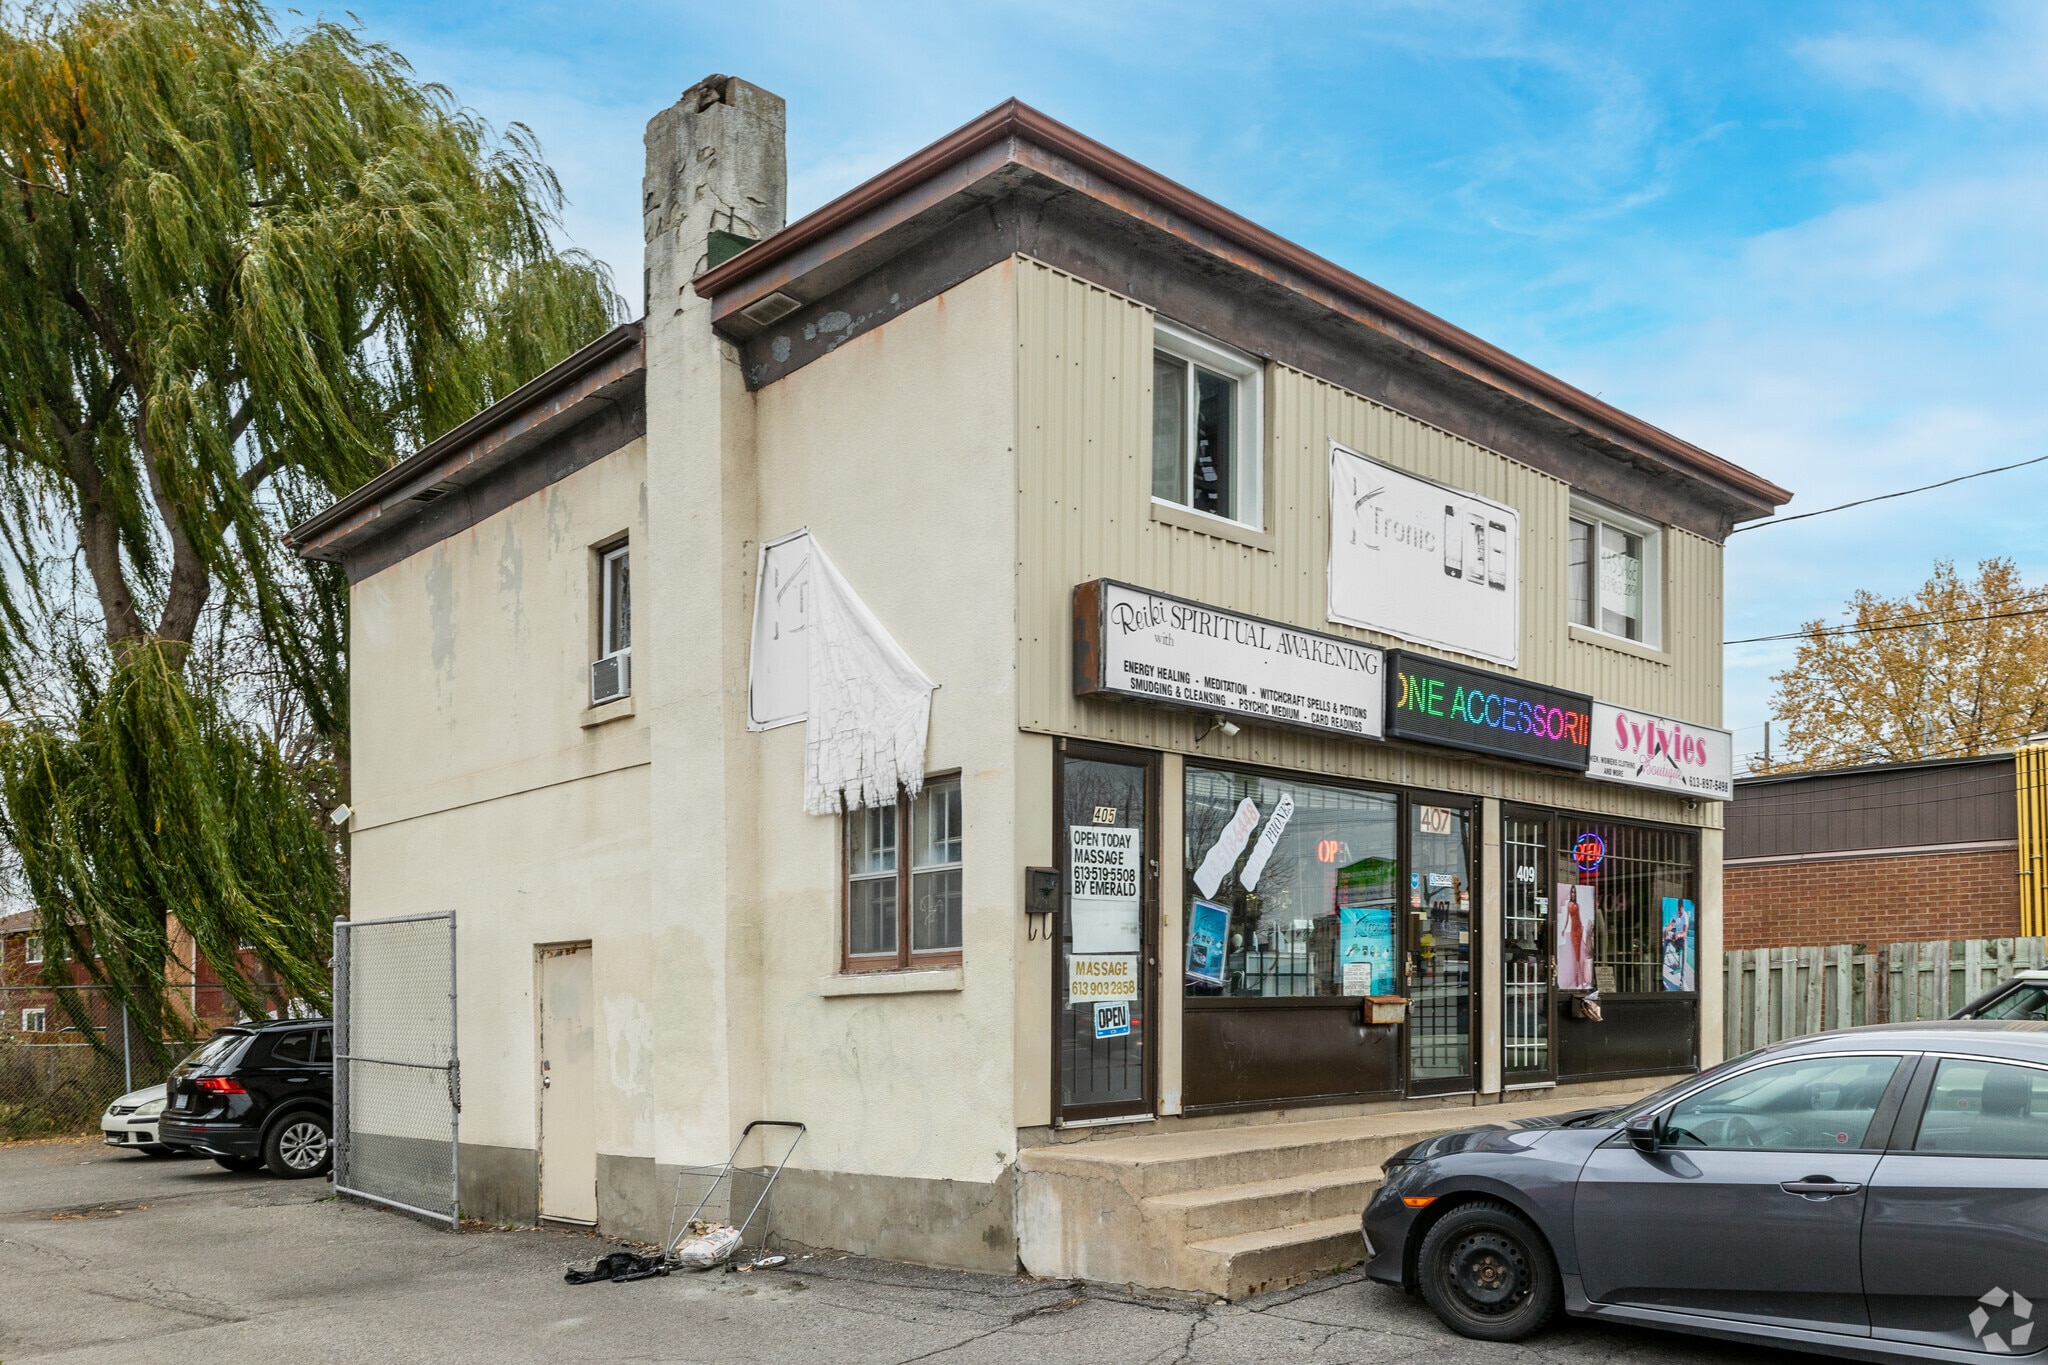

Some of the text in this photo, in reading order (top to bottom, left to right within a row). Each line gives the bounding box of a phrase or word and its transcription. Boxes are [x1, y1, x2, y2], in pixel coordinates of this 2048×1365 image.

[1111, 596, 1378, 675] Reiki SPIRITUAL AWAKENING
[1154, 632, 1175, 647] with
[1123, 660, 1155, 677] ENERGY
[1157, 667, 1191, 684] HEALING
[1204, 676, 1248, 695] MEDITATION
[1260, 688, 1305, 707] WITCHCRAFT
[1307, 697, 1331, 713] SPELLS
[1332, 702, 1338, 714] &
[1340, 704, 1368, 720] POTIONS
[1130, 677, 1173, 696] SMUDGING
[1175, 685, 1182, 698] &
[1184, 687, 1226, 706] CLEANSING
[1238, 698, 1269, 714] PSYCHIC
[1271, 704, 1300, 720] MEDIUM
[1311, 712, 1329, 726] CARD
[1331, 716, 1363, 732] READINGS
[1450, 686, 1589, 746] ACCESSORI
[1615, 712, 1707, 768] Sylvies
[1604, 767, 1624, 778] AND MORE
[1094, 808, 1115, 823] 405
[1265, 798, 1292, 845] PHONES
[1421, 808, 1450, 832] 407
[1074, 830, 1132, 849] OPEN TODAY
[1074, 848, 1124, 866] MASSAGE
[1317, 840, 1352, 863] OPEN
[1074, 866, 1136, 882] 613-519-5508
[1516, 865, 1535, 883] 409
[1075, 880, 1137, 897] BY EMERALD
[1076, 961, 1128, 976] MASSAGE
[1071, 980, 1135, 997] 613 903 2858
[1098, 1006, 1126, 1029] OPEN
